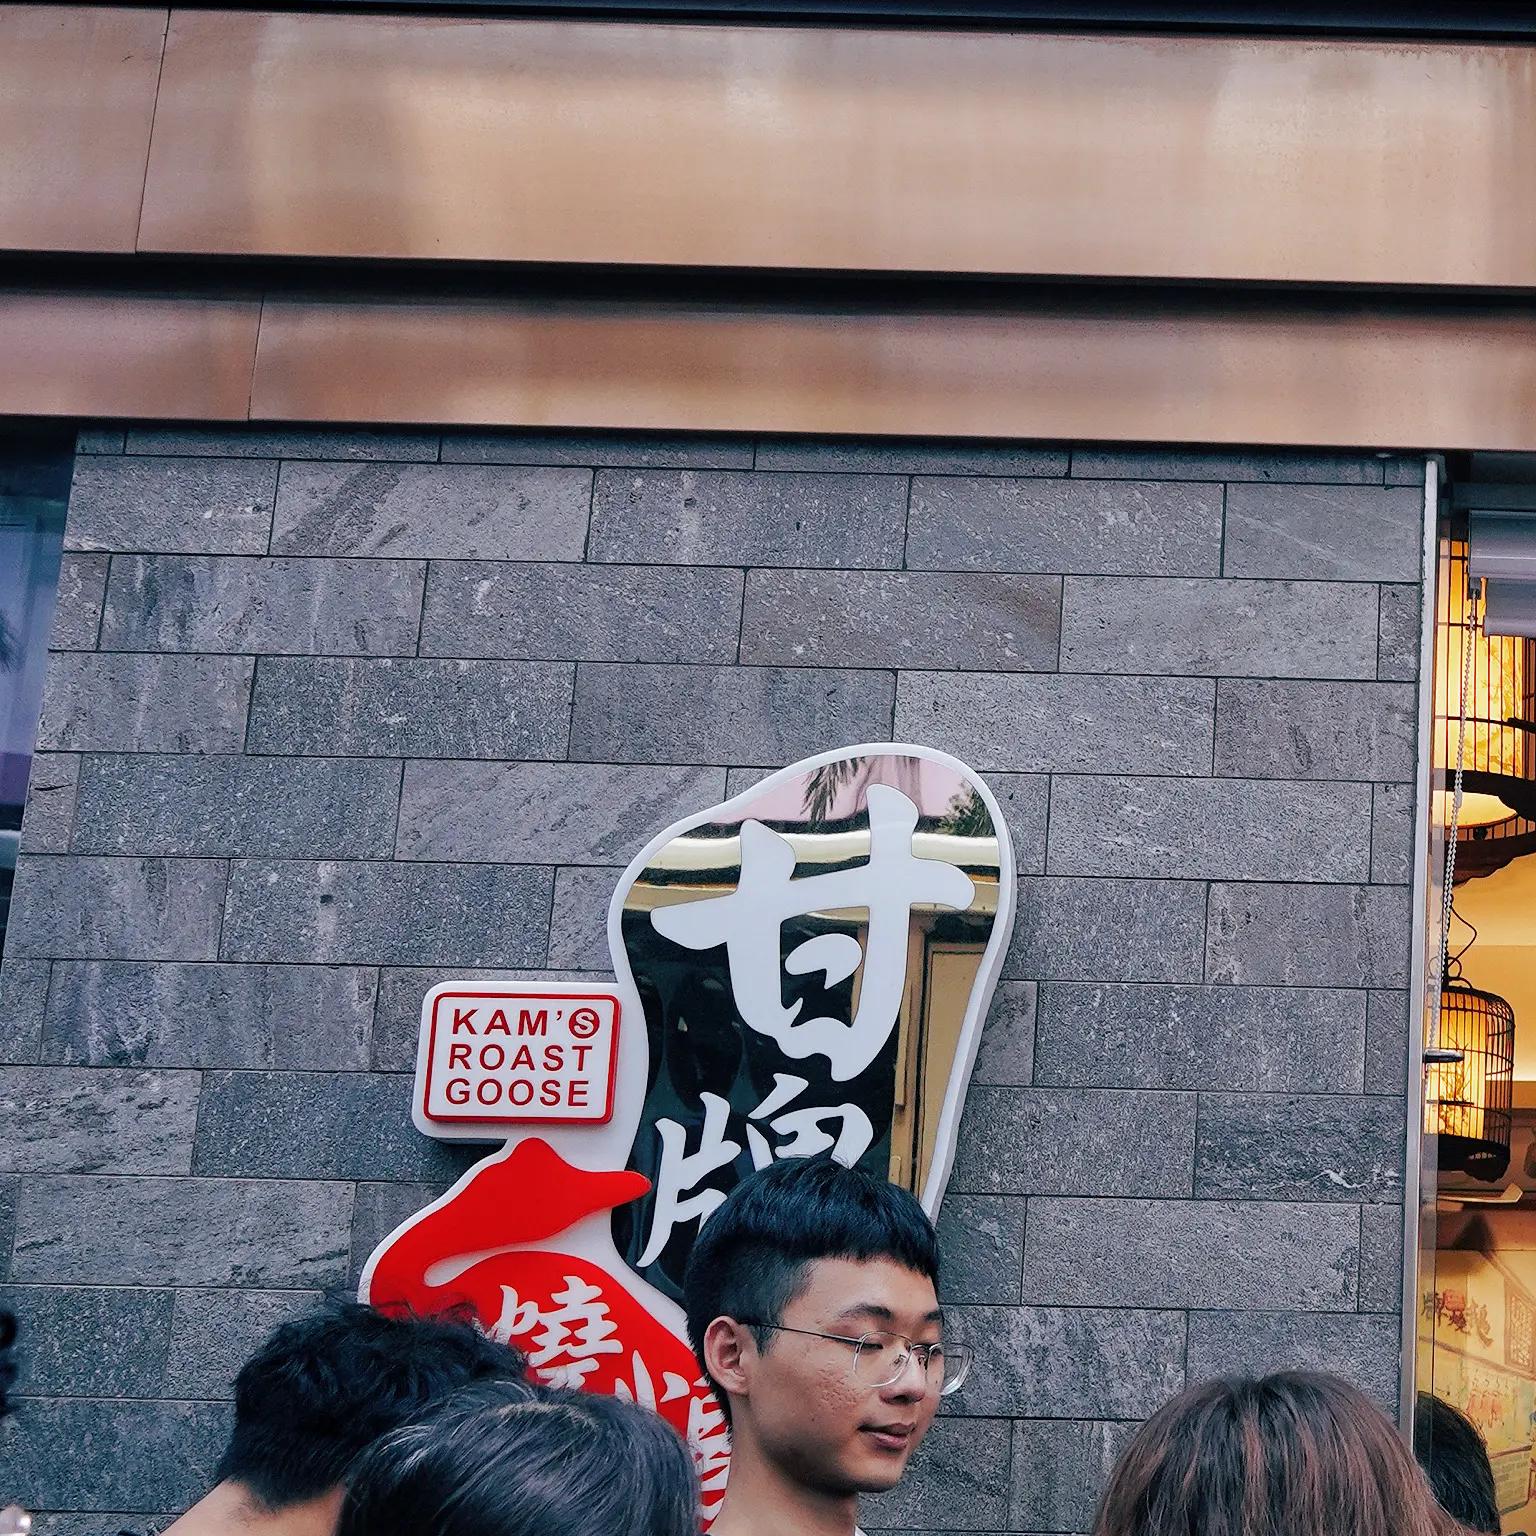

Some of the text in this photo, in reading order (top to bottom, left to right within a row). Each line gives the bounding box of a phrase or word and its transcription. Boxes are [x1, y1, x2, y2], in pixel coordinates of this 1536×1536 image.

[452, 1007, 601, 1039] KAM'S
[448, 1043, 593, 1072] ROAST
[445, 1077, 589, 1107] GOOSE
